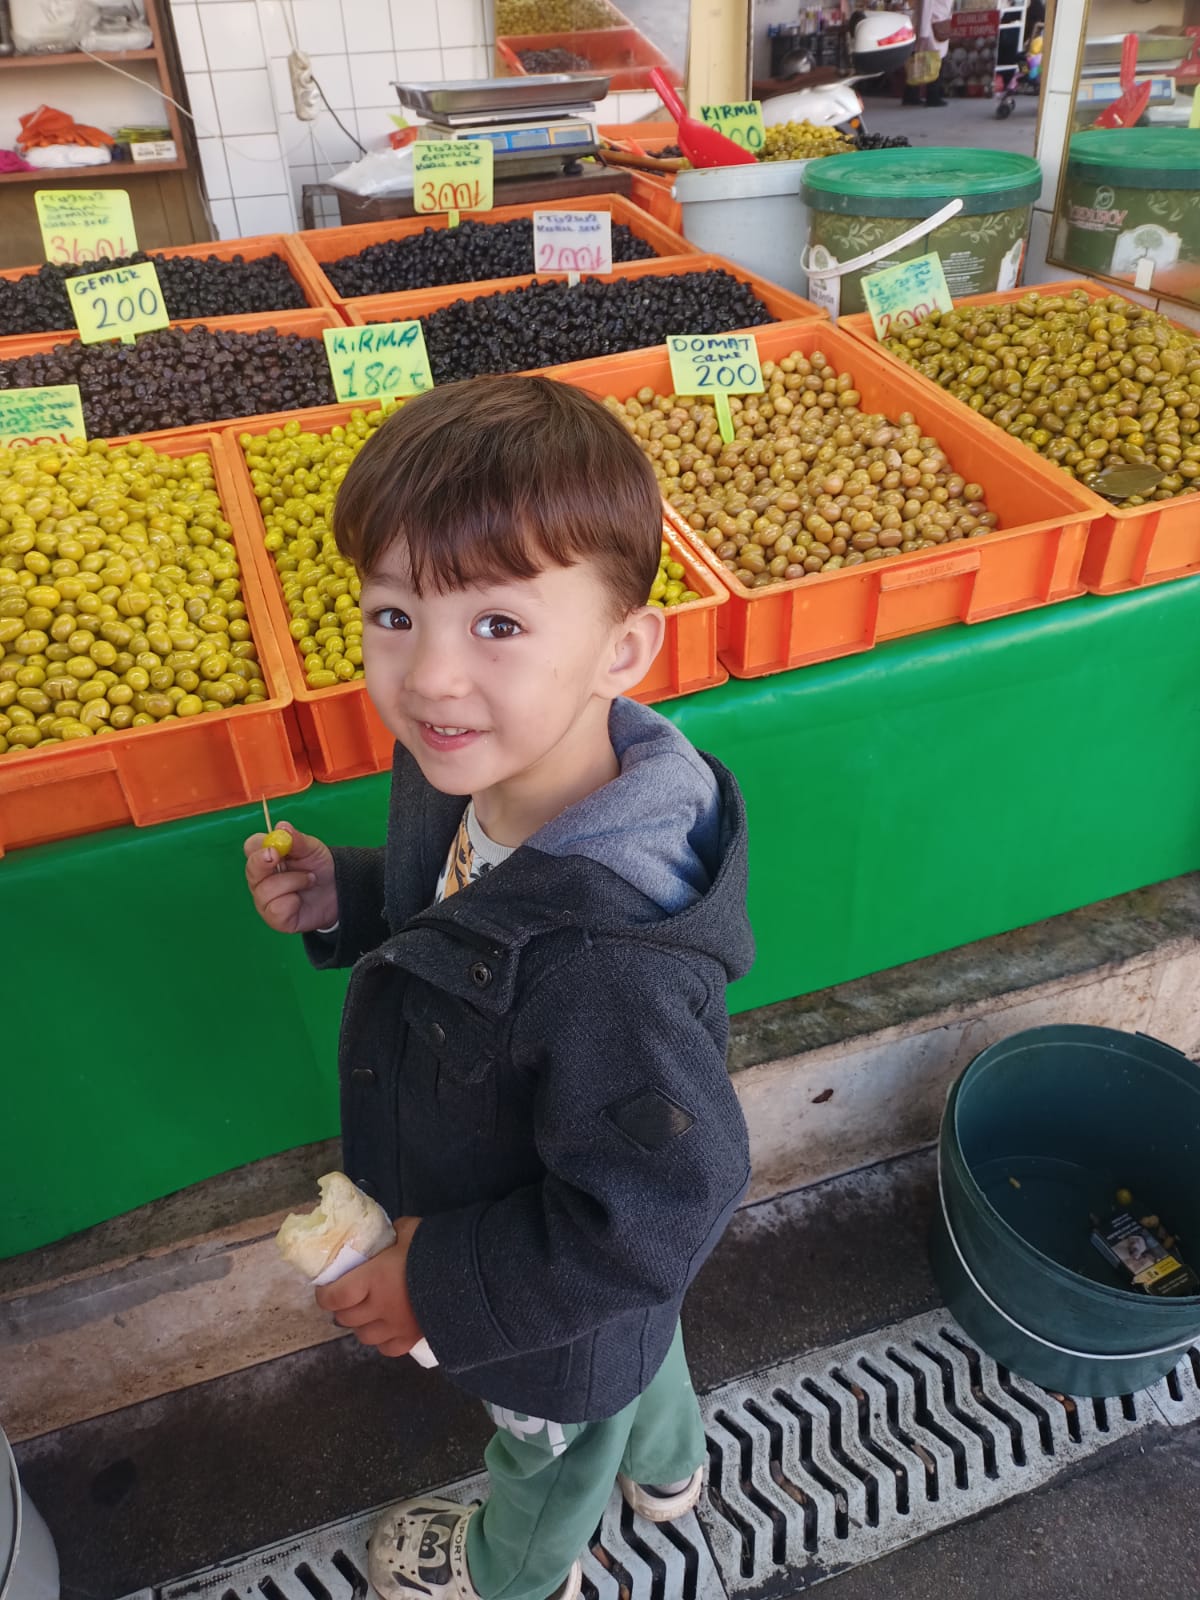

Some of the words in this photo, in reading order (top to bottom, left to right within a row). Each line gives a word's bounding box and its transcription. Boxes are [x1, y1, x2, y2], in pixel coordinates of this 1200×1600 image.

[700, 102, 758, 121] KIRMA
[92, 287, 158, 330] 200
[333, 325, 419, 354] KIRMA
[672, 337, 751, 353] DOMAT
[340, 359, 402, 398] 180
[695, 363, 757, 387] 200
